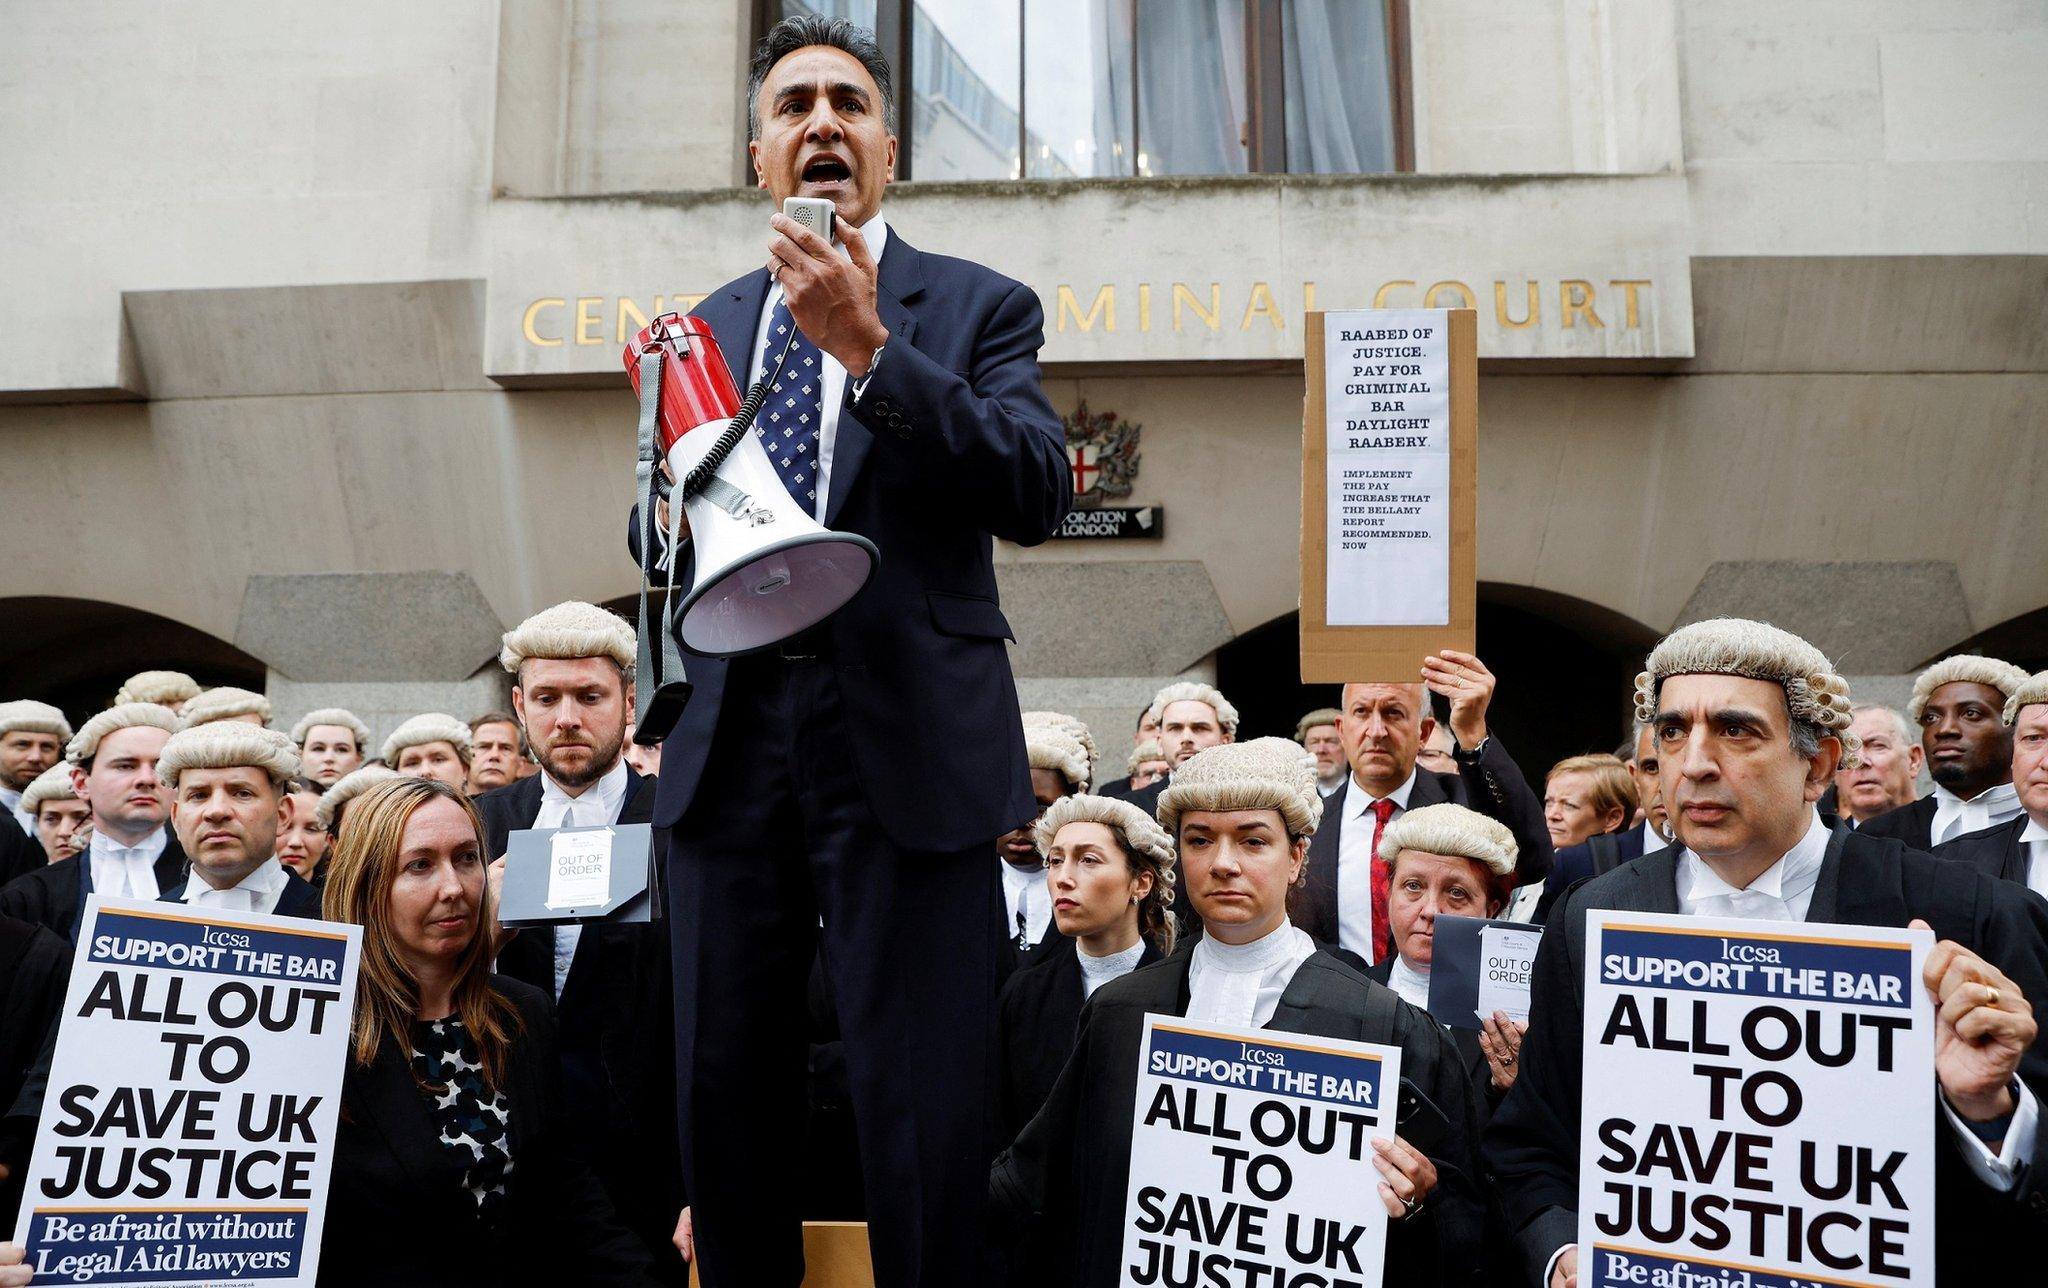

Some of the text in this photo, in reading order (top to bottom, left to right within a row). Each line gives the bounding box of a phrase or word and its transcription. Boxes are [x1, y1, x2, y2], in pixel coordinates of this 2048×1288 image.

[1372, 279, 1652, 329] COURT
[1341, 328, 1433, 341] RAABED OF
[1353, 347, 1427, 359] JUSTICE.
[1353, 365, 1422, 376] PAY FOR
[1345, 383, 1431, 395] CRIMINAL
[1371, 401, 1405, 412] BAR
[1346, 418, 1430, 430] DAYLIGHT
[1349, 436, 1431, 448] RAABERY.
[1343, 470, 1413, 479] IMPLEMENT
[1343, 482, 1390, 490] THE PAY
[1342, 494, 1431, 503] INCREASE THAT
[1342, 506, 1421, 514] THE BELLAMY
[1067, 511, 1126, 523] ORATION
[1342, 518, 1385, 526] REPORT
[1062, 524, 1119, 537] LONDON
[1342, 530, 1431, 539] RECOMMENDED.
[1342, 542, 1367, 550] NOW
[559, 853, 604, 865] OUT OF
[559, 864, 602, 876] ORDER
[202, 925, 250, 948] lccsa
[93, 935, 337, 981] SUPPORT THE BAR
[1721, 938, 1781, 964] lccsa
[1489, 957, 1531, 972] OUT O
[1604, 955, 1903, 1003] SUPPORT THE BAR
[77, 970, 341, 1035] ALL OUT
[1600, 993, 1912, 1072] ALL OUT
[160, 1032, 251, 1084] TO
[1240, 1043, 1285, 1067] lccsa
[1150, 1050, 1373, 1104] SUPPORT THE BAR
[1693, 1064, 1803, 1128] TO
[53, 1084, 324, 1144] SAVE UK
[1143, 1083, 1378, 1161] ALL OUT
[40, 1146, 317, 1200] JUSTICE
[1212, 1145, 1293, 1201] TO
[1596, 1117, 1909, 1211] SAVE UK
[40, 1213, 296, 1243] Be afraid without
[1134, 1185, 1367, 1275] SAVE UK
[1594, 1181, 1911, 1280] JUSTICE
[33, 1244, 291, 1282] Legal Aid lawyers
[1129, 1238, 1363, 1288] JUST
[1604, 1253, 1648, 1284] Be
